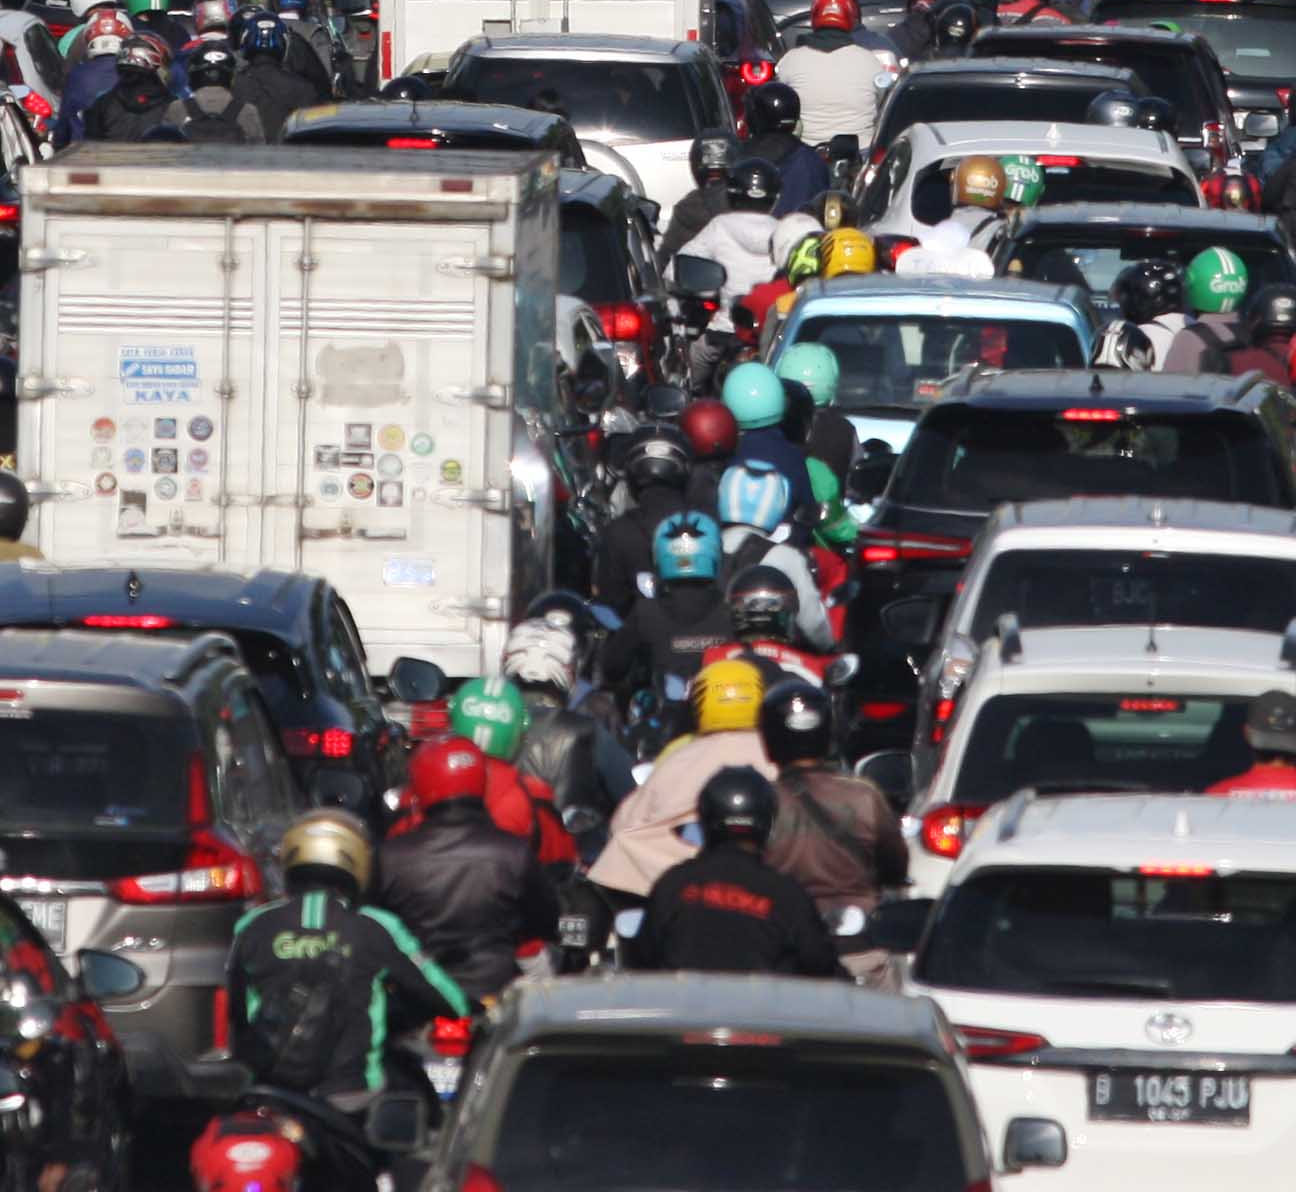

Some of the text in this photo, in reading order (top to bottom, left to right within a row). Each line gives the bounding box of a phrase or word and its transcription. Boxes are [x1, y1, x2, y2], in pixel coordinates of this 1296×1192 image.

[1004, 163, 1040, 183] Grab
[1209, 275, 1247, 294] Grab
[461, 695, 514, 724] Grab
[1134, 1074, 1193, 1107] 1045
[1199, 1076, 1250, 1110] PJU
